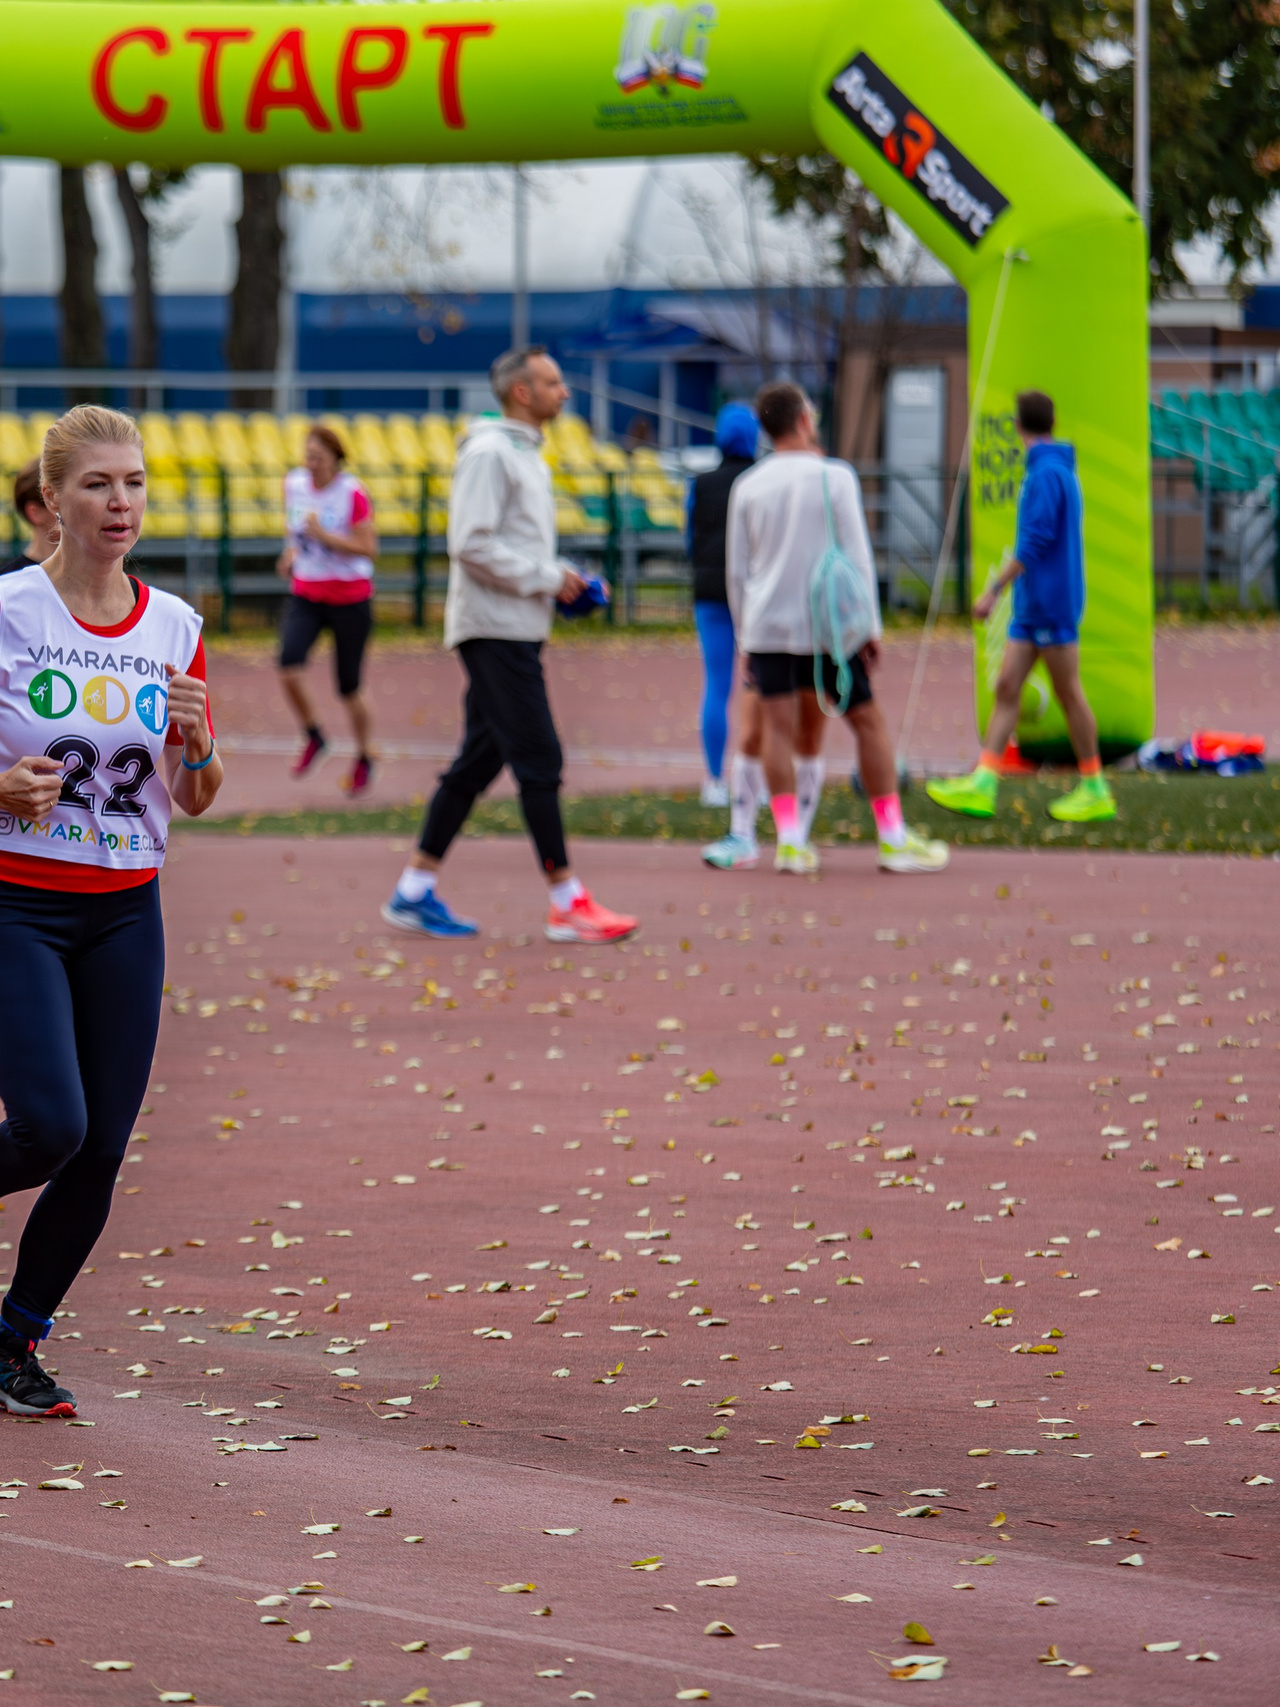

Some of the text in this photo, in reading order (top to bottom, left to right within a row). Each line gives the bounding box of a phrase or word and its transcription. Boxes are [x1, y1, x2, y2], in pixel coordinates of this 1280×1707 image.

[91, 24, 496, 133] СТАРТ
[916, 149, 994, 238] Sport
[43, 734, 157, 818] 22
[18, 818, 167, 853] VMARAFONE.CLU
